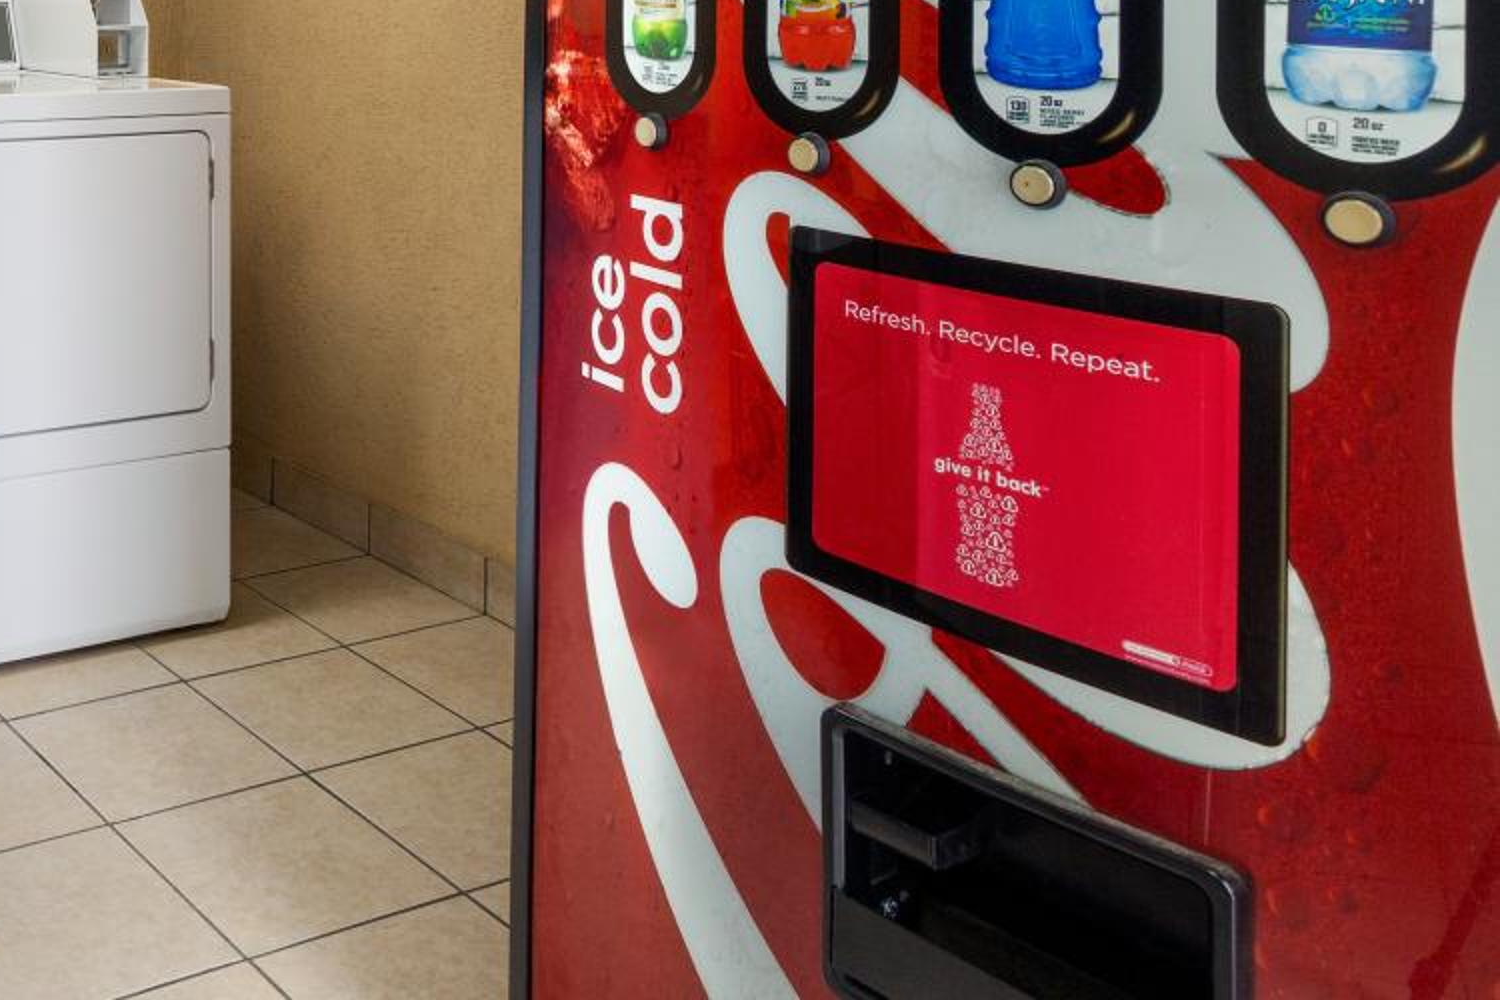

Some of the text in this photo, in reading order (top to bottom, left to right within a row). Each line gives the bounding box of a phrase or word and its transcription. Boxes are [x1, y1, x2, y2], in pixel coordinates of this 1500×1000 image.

[581, 255, 626, 393] ice
[630, 193, 684, 415] cold
[845, 299, 1162, 384] Refresh. Recycle. Repeat.
[935, 458, 1042, 499] give it back
